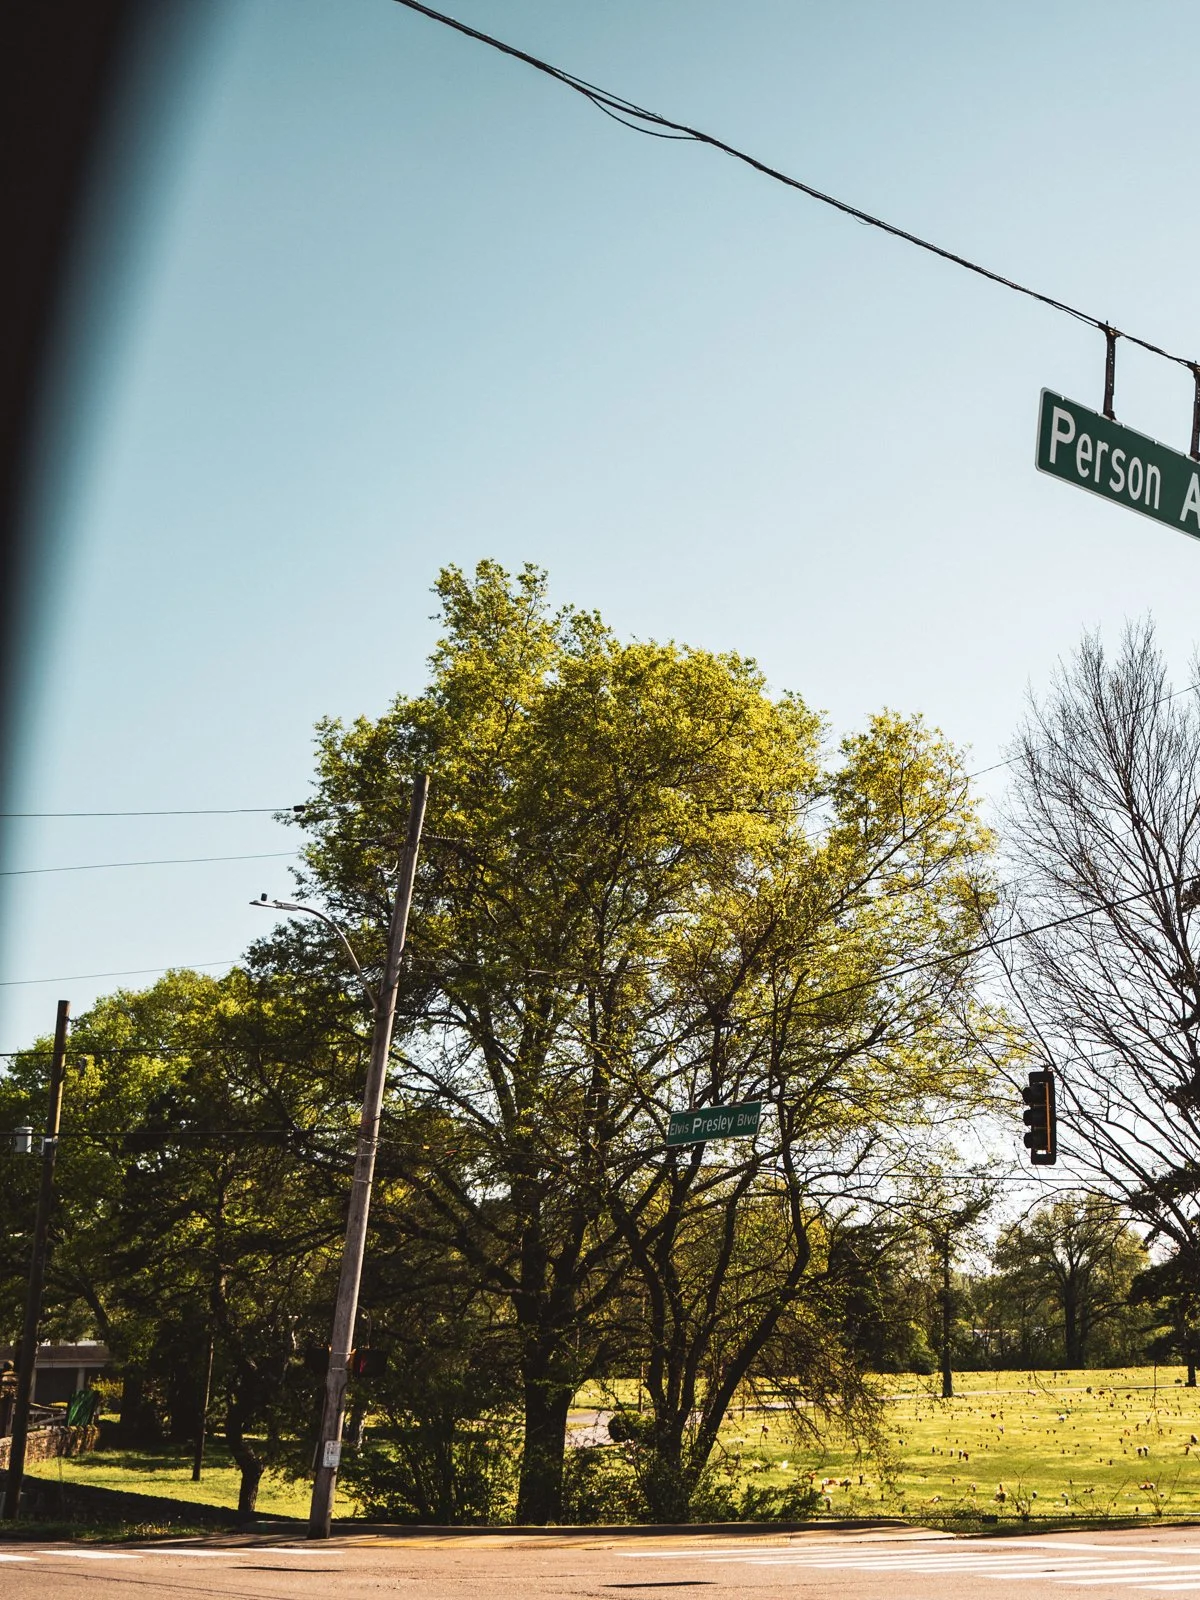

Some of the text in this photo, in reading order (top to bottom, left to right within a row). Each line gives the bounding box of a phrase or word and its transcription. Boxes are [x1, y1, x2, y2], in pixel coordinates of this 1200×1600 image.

[1049, 406, 1161, 510] Person
[669, 1113, 758, 1135] Elvis Presley Blvd
